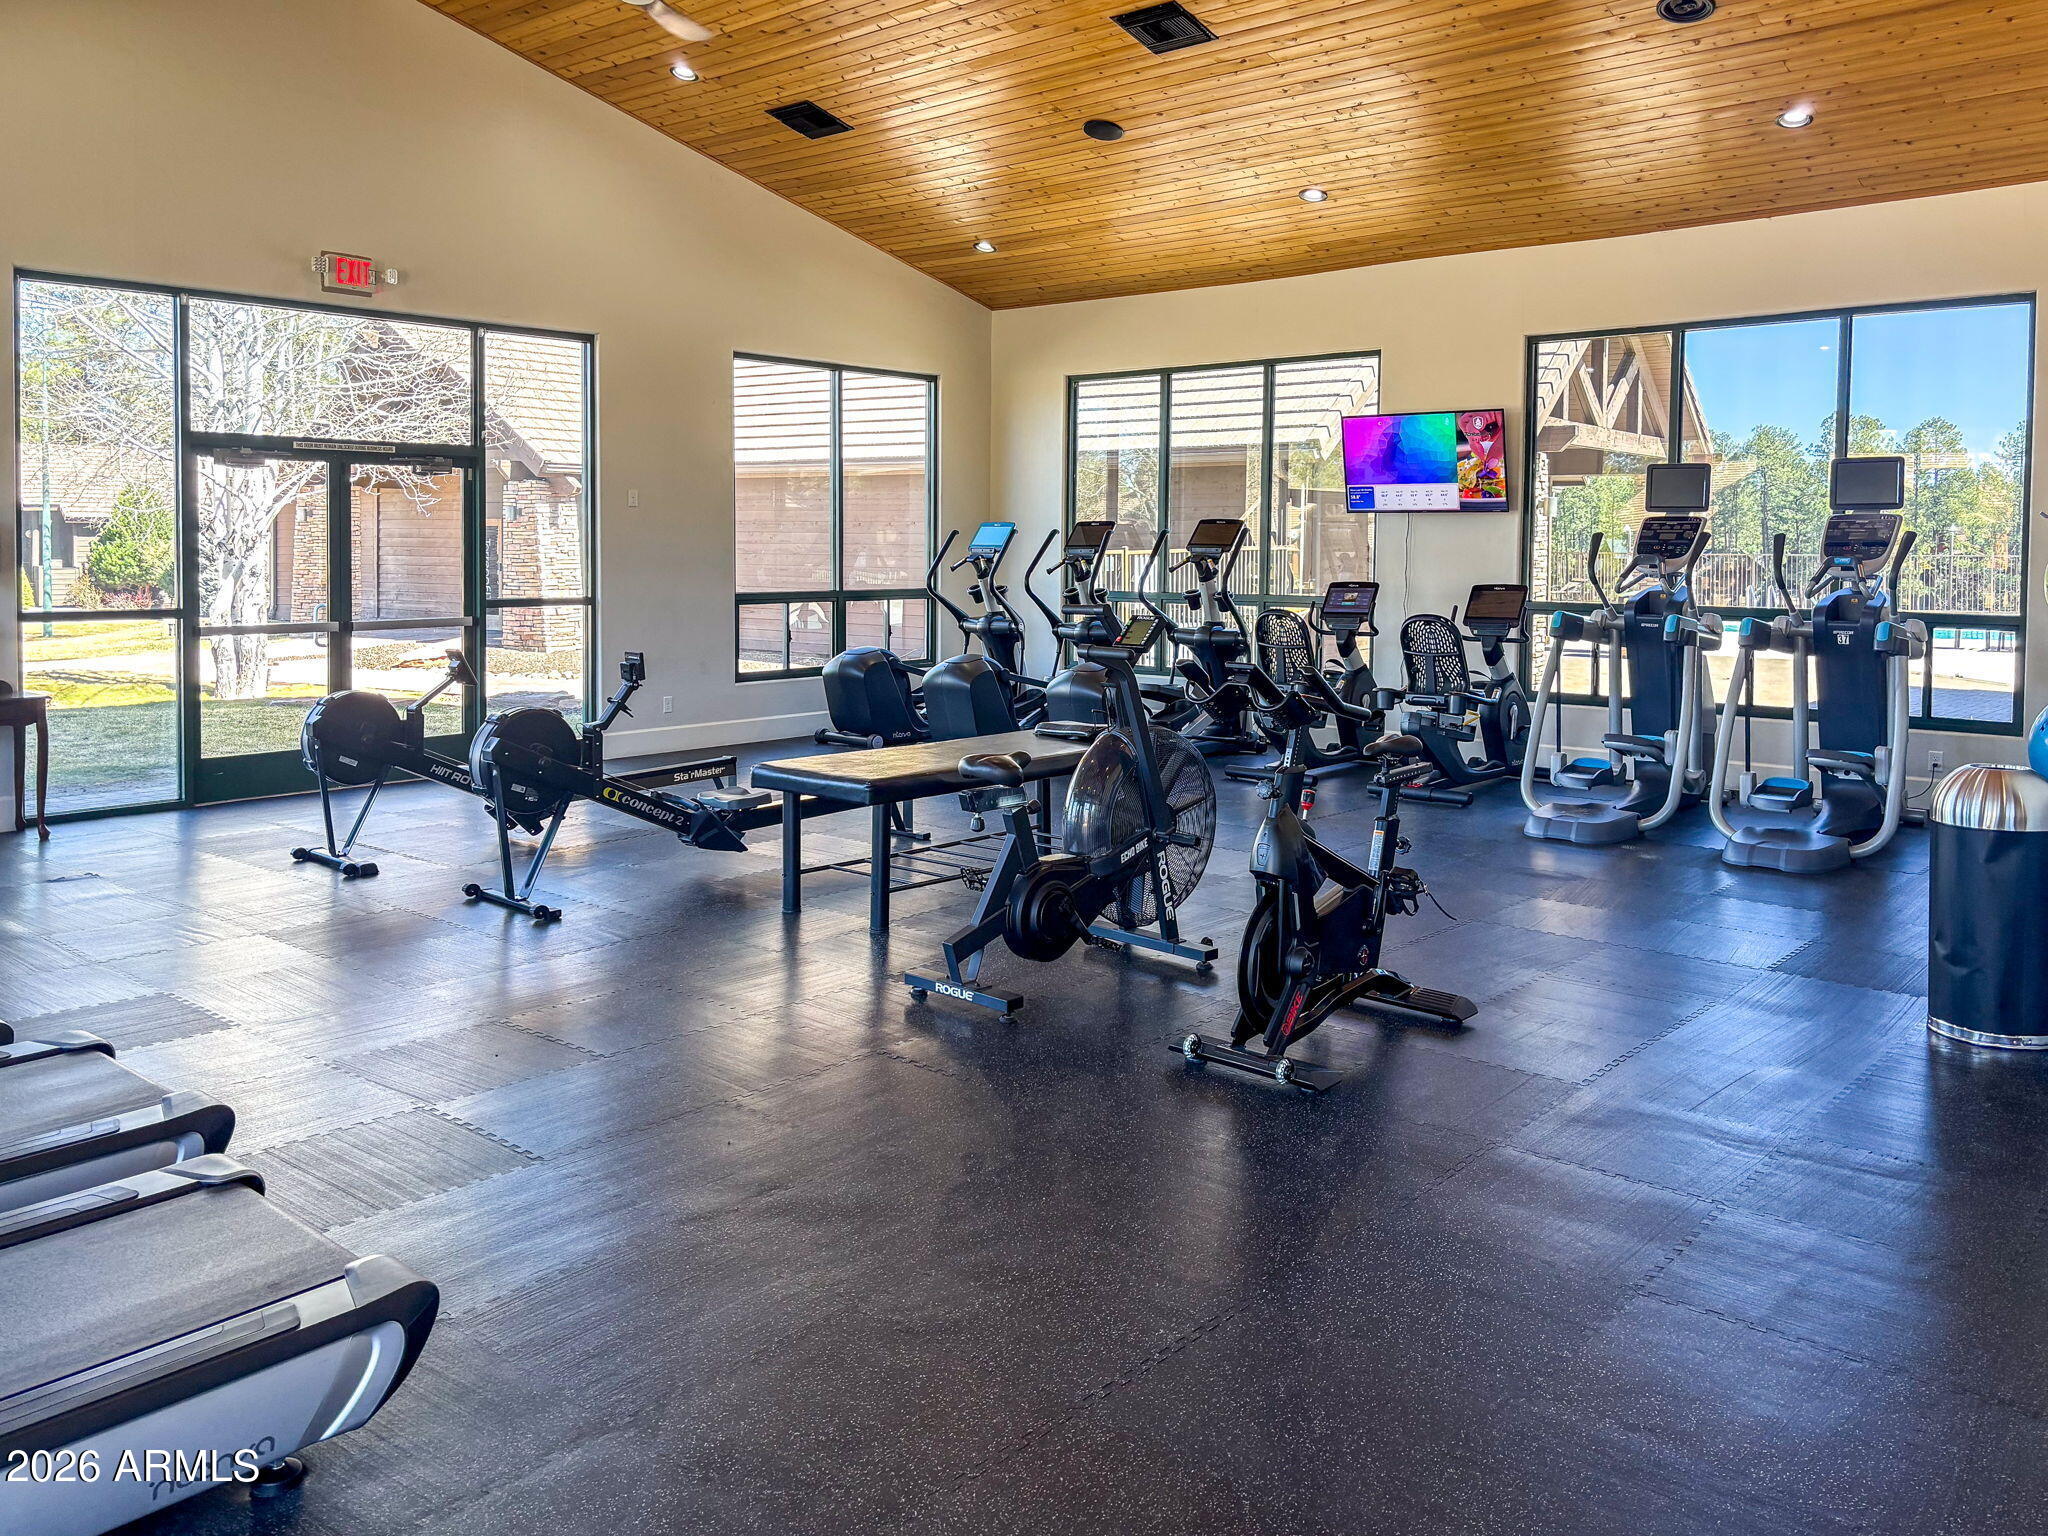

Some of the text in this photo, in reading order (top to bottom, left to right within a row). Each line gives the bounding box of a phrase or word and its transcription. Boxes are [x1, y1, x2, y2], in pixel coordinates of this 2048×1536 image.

[336, 256, 371, 288] EXIT
[1838, 634, 1849, 644] 37
[430, 764, 472, 785] HIIT RO
[621, 795, 684, 826] concept 2
[1120, 837, 1149, 864] ECHO BIKE
[1157, 850, 1175, 920] ROGUE
[935, 982, 975, 1001] ROGUE
